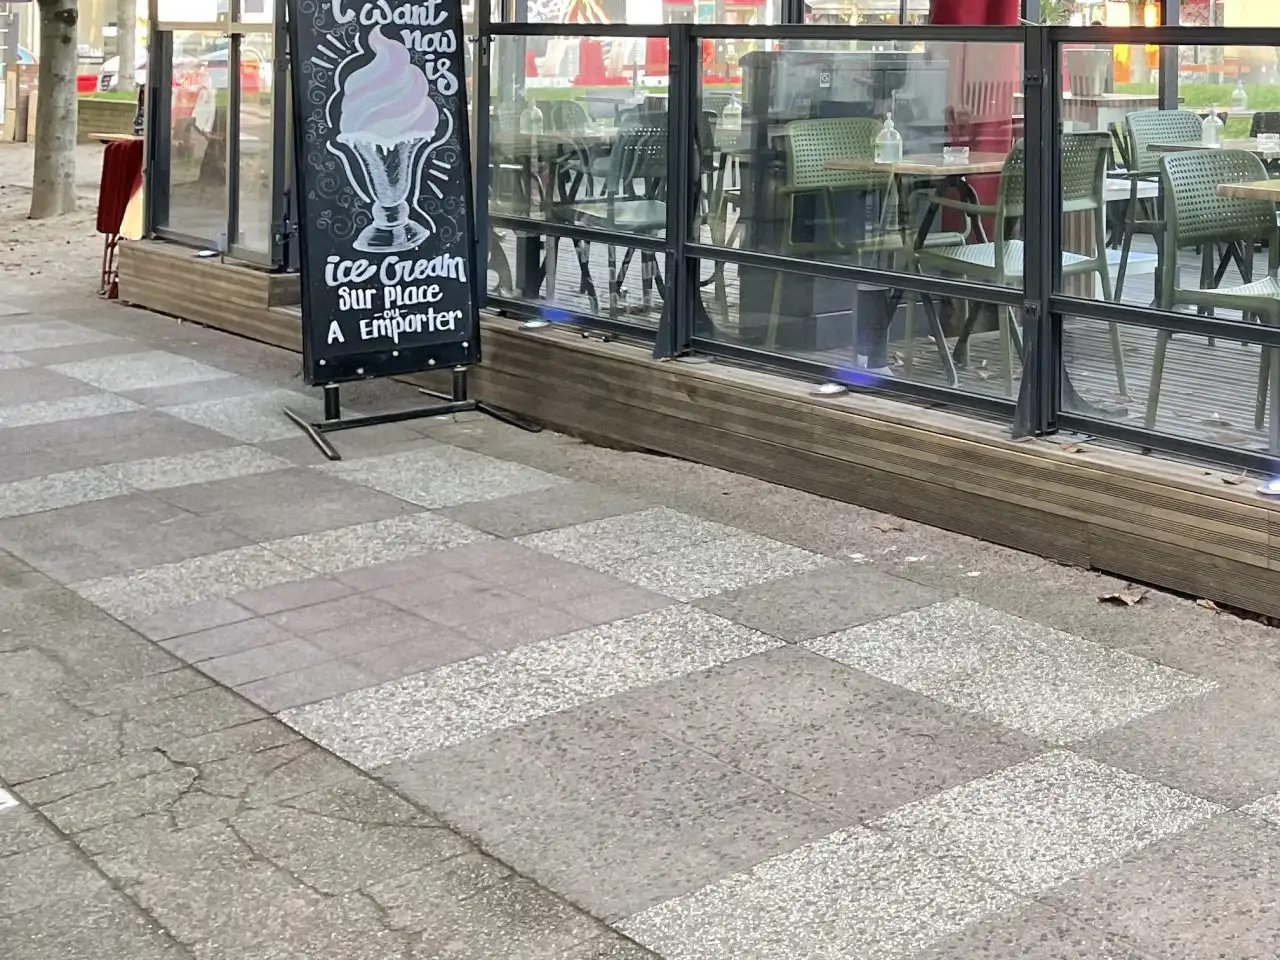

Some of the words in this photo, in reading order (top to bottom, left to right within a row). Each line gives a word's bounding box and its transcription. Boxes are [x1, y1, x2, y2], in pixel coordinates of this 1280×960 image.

[400, 29, 457, 53] now
[424, 54, 459, 96] is
[324, 255, 378, 287] ice
[379, 253, 467, 286] Cream
[338, 286, 377, 311] Sur
[383, 284, 444, 310] Place
[327, 320, 345, 345] A
[359, 307, 463, 344] Emporter
